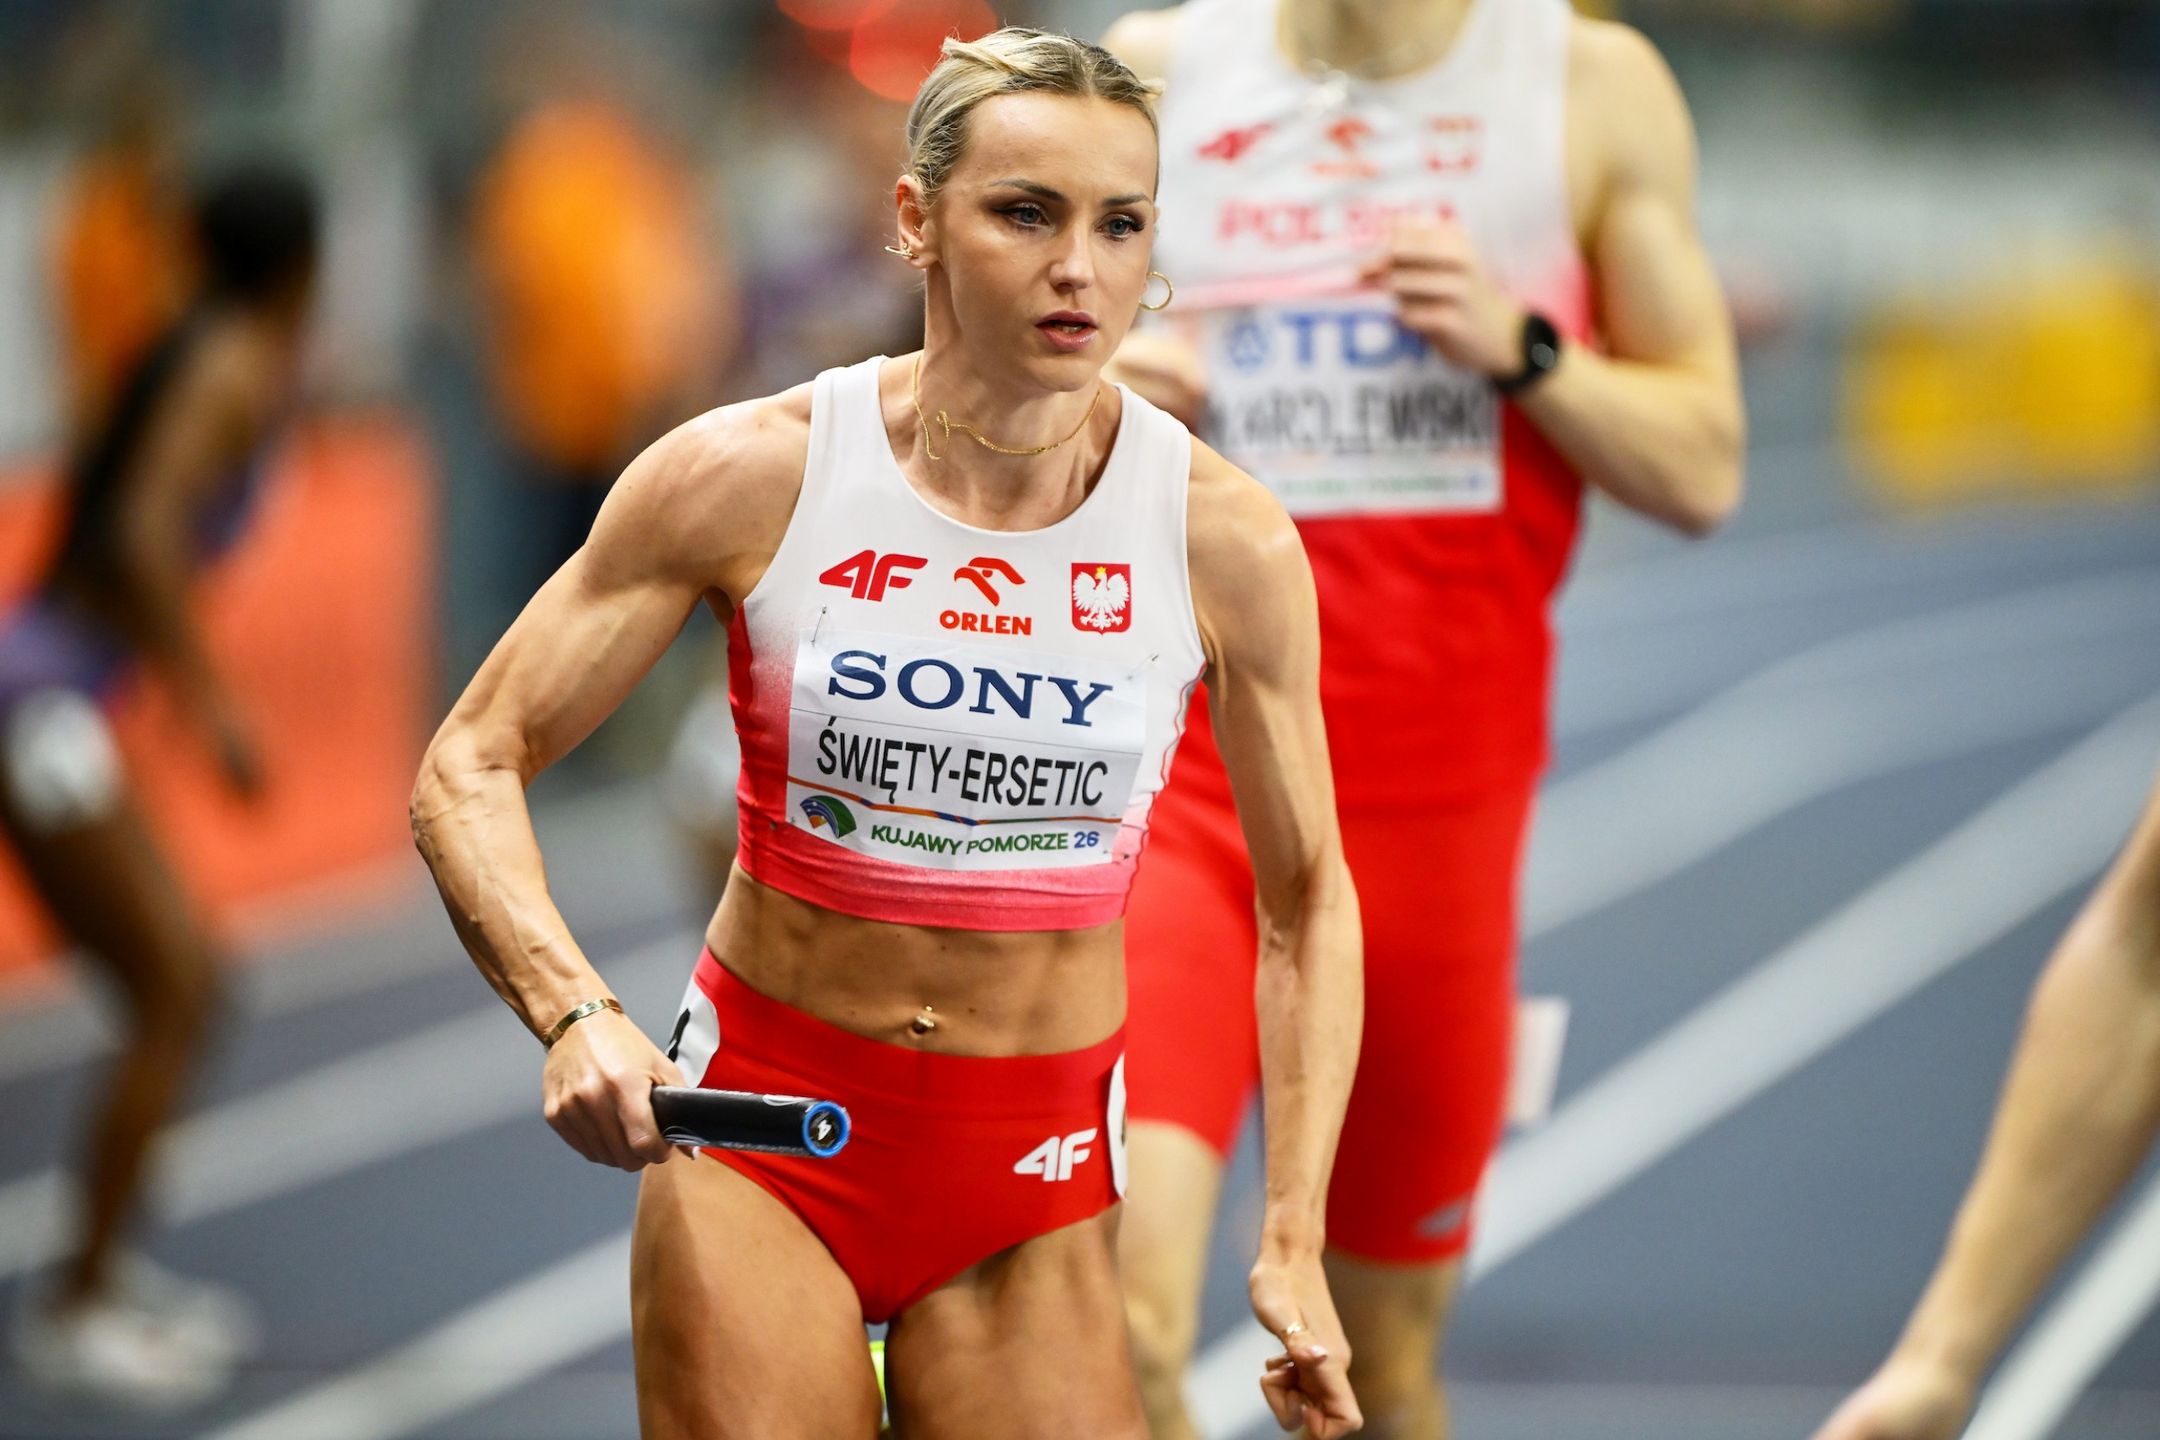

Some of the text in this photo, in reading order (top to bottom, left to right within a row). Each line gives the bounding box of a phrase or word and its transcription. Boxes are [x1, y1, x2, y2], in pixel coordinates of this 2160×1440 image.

[1218, 198, 1458, 248] POLS
[818, 549, 929, 602] 4F
[939, 609, 1032, 636] ORLEN
[828, 649, 1114, 728] SONY
[816, 715, 1109, 807] ŚWIĘTY-ERSETIC
[870, 823, 1101, 856] KUJAWY POMORZE 26
[1013, 1127, 1098, 1182] 4F
